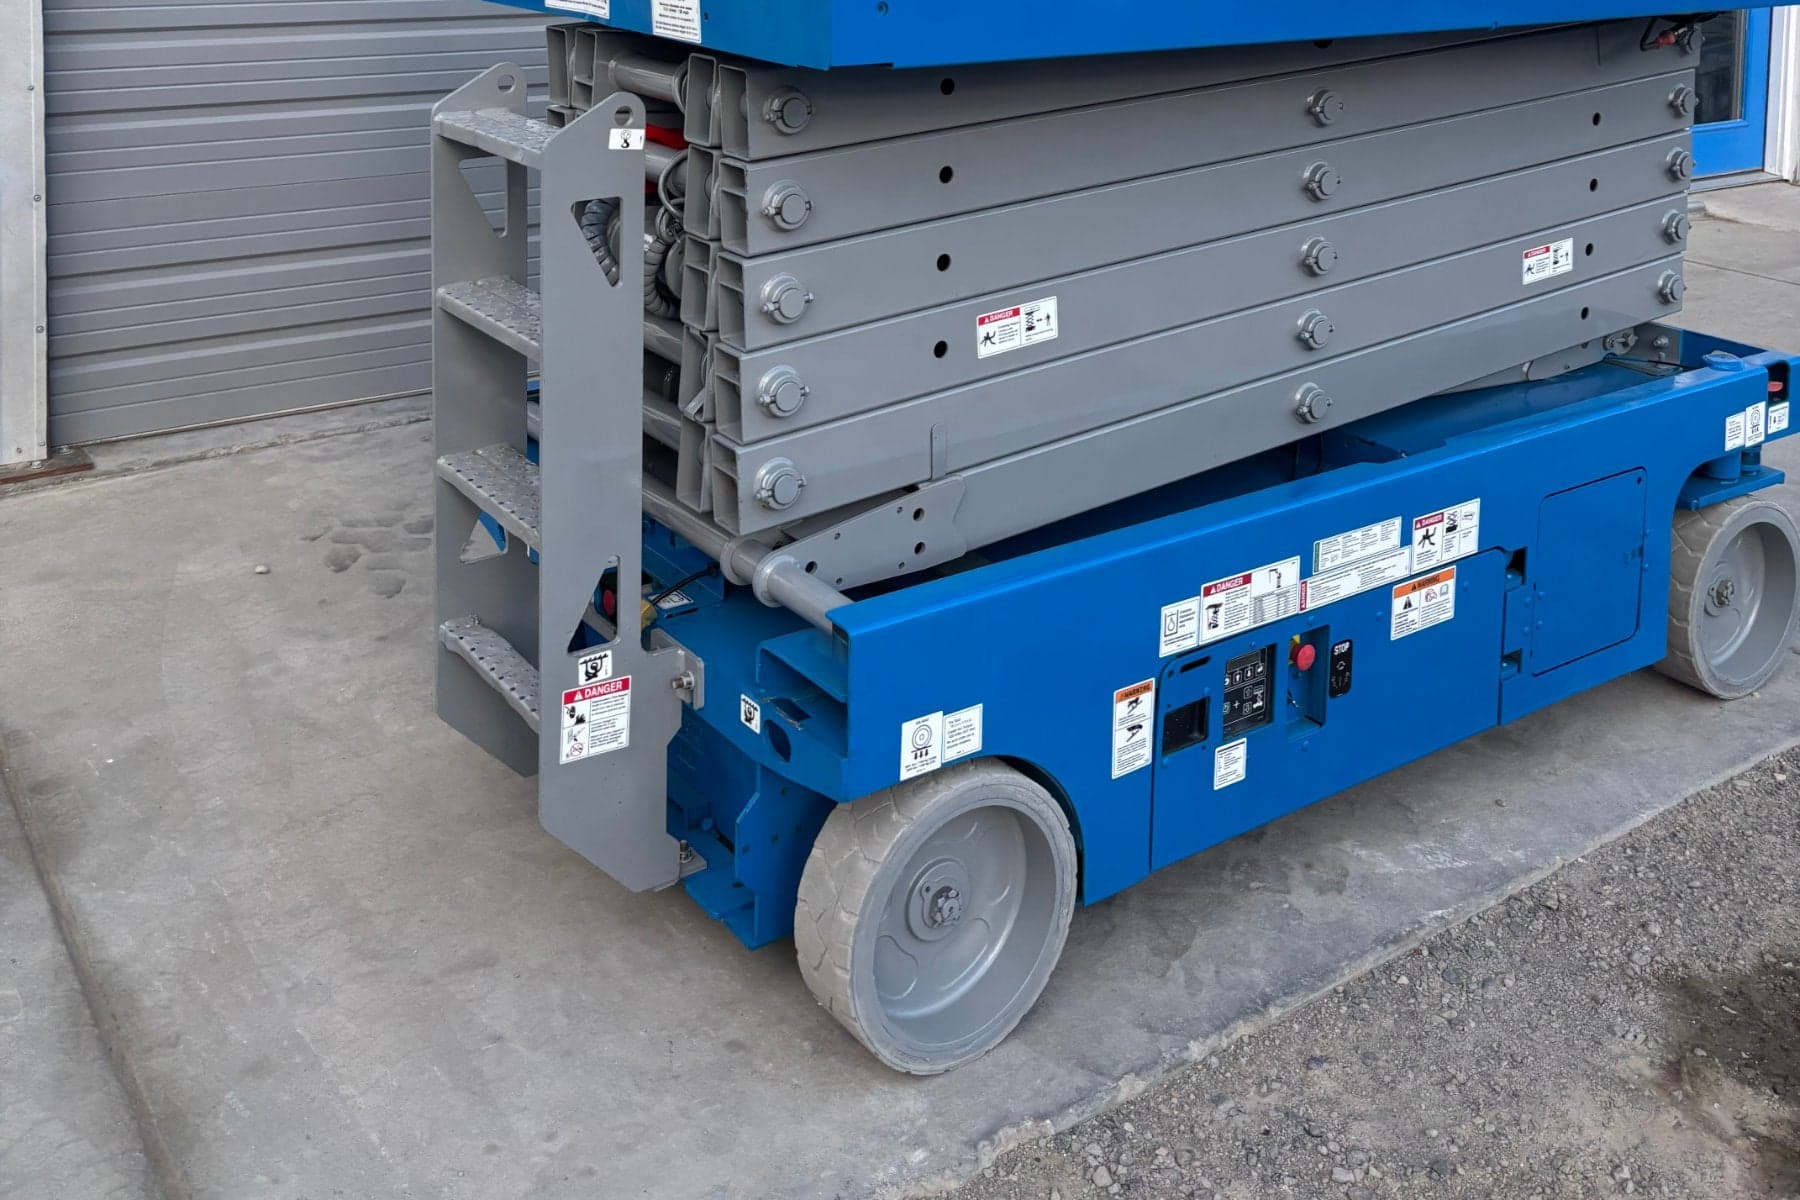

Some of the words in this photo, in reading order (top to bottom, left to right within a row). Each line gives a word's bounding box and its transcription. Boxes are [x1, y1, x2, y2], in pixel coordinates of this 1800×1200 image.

[1216, 576, 1243, 591] DANGER
[1334, 642, 1350, 655] STOP
[584, 681, 622, 699] DANGER
